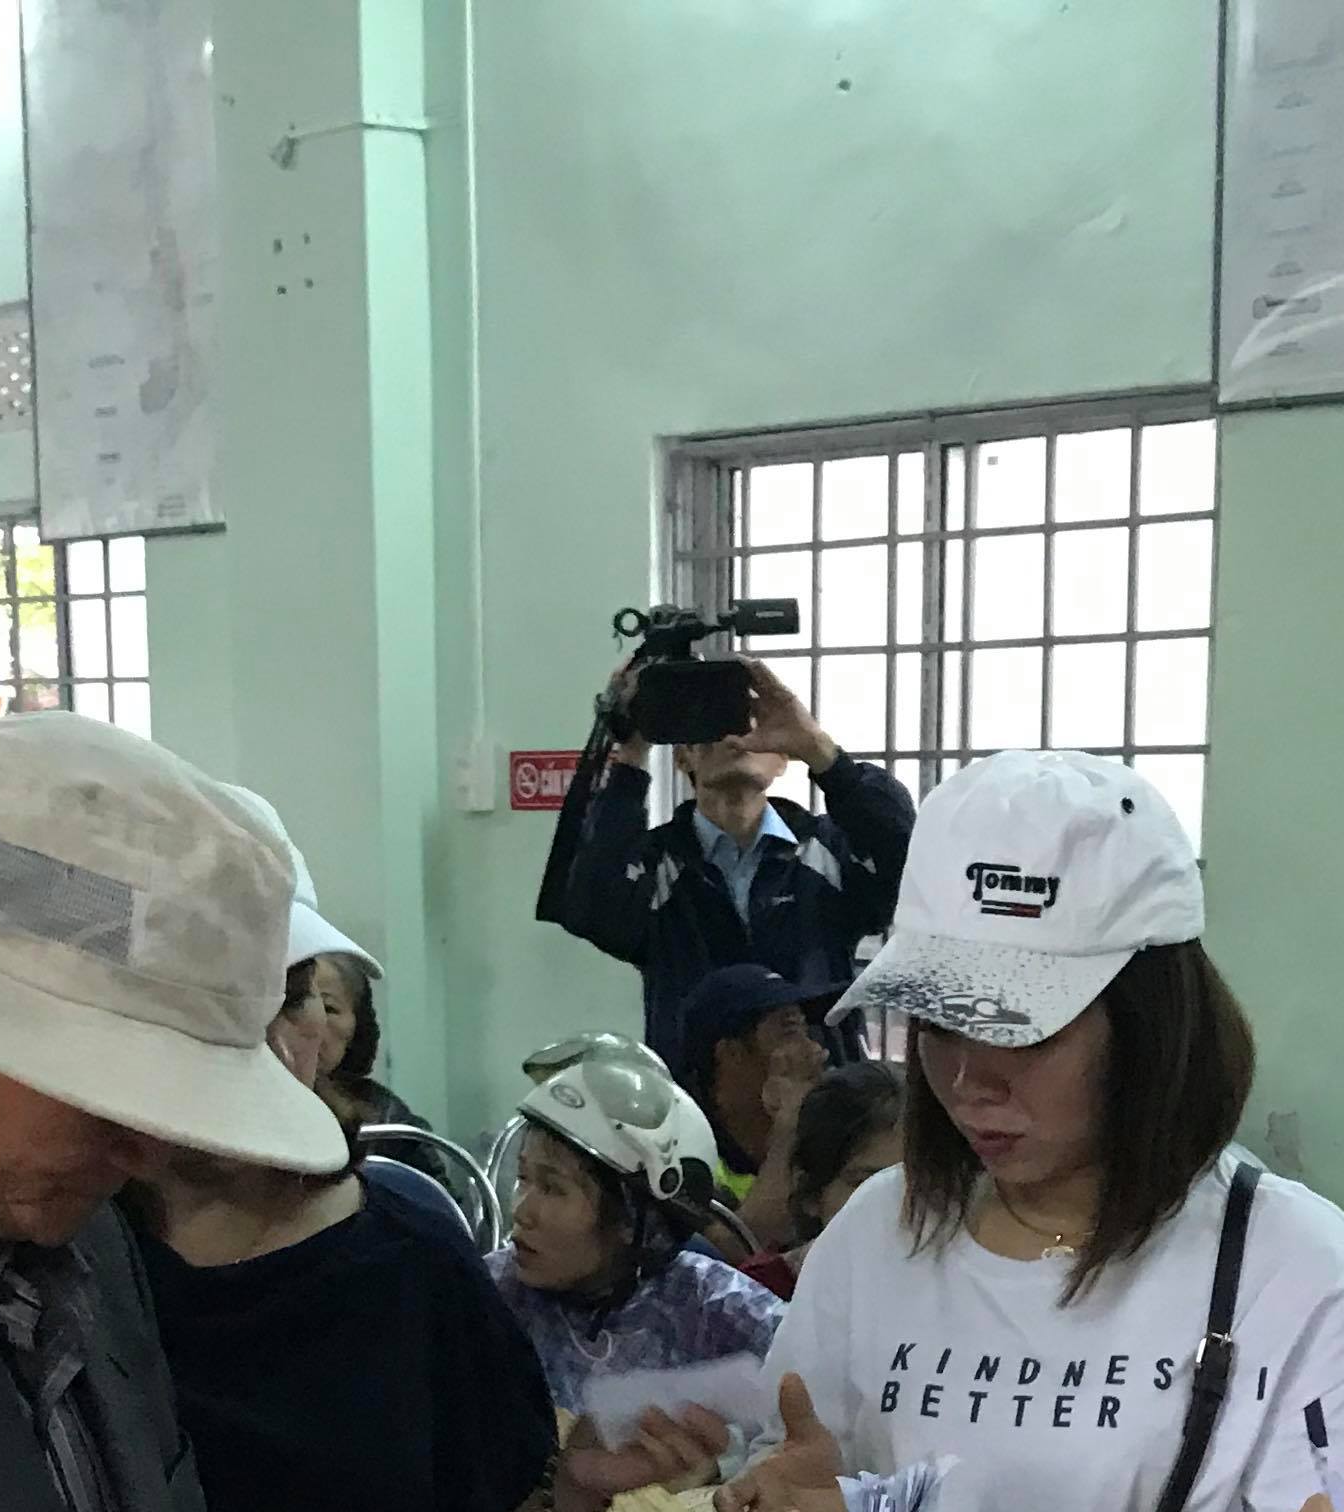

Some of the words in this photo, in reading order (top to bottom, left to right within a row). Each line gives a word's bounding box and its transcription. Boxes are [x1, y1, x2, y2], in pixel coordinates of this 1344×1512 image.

[965, 862, 1061, 909] Tommy
[889, 1342, 1176, 1391] KINDNES
[880, 1381, 1121, 1428] BETTER
